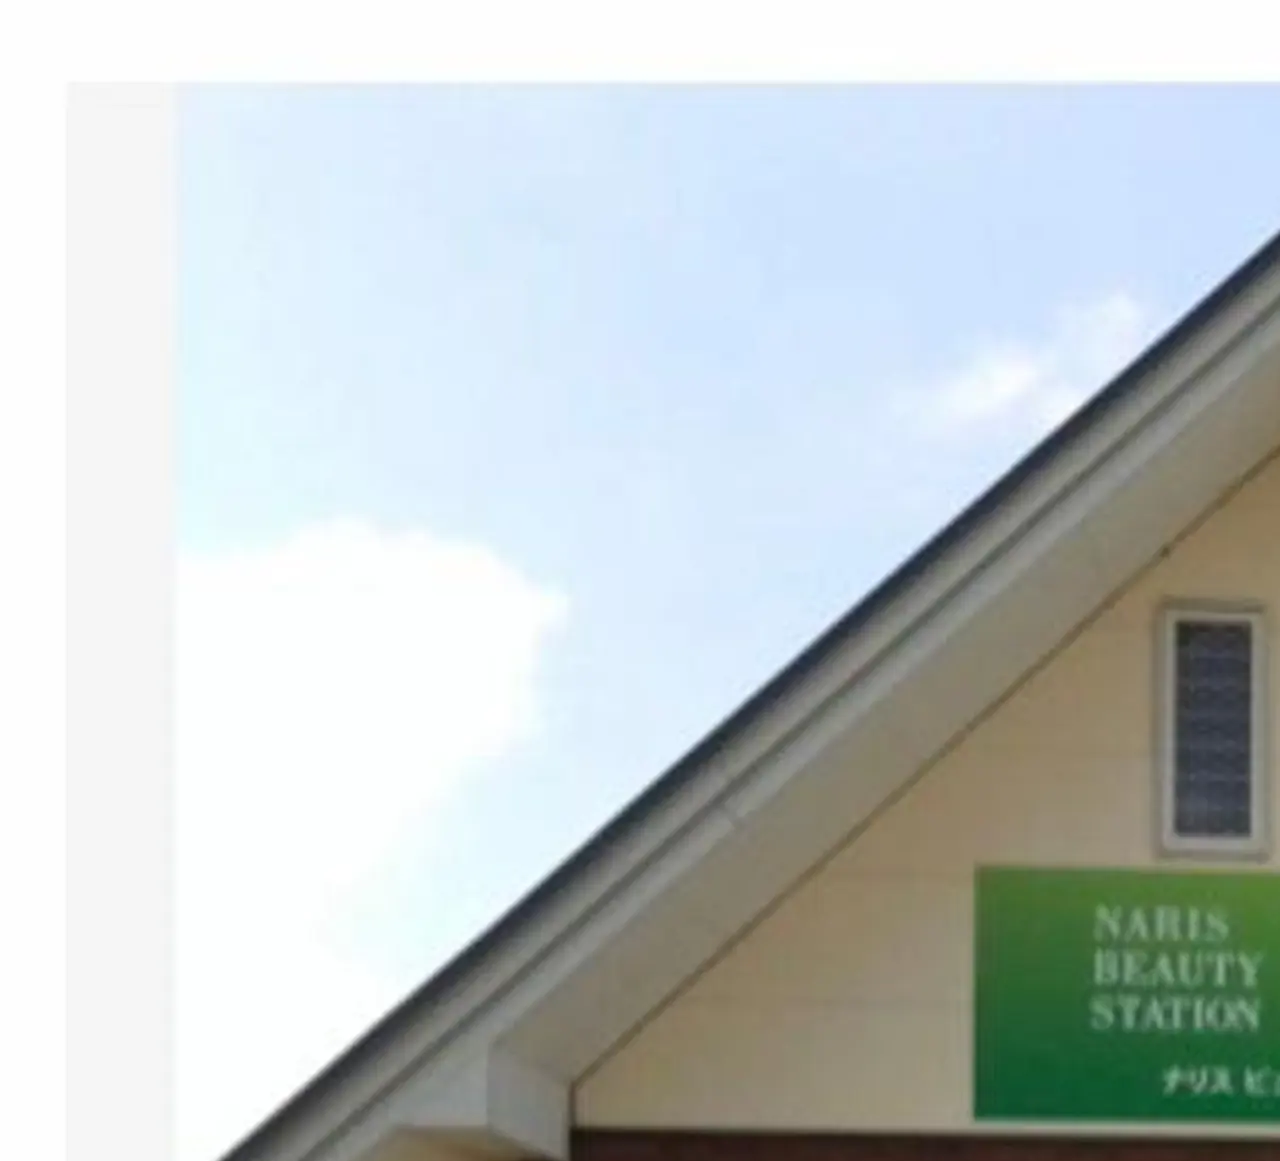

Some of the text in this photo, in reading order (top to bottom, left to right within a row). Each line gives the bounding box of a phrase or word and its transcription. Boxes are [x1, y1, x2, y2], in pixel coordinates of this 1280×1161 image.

[1093, 903, 1229, 942] NARIS
[1094, 947, 1263, 988] BEAUTY
[1090, 995, 1261, 1033] STATION
[1163, 1064, 1233, 1097] ナリス
